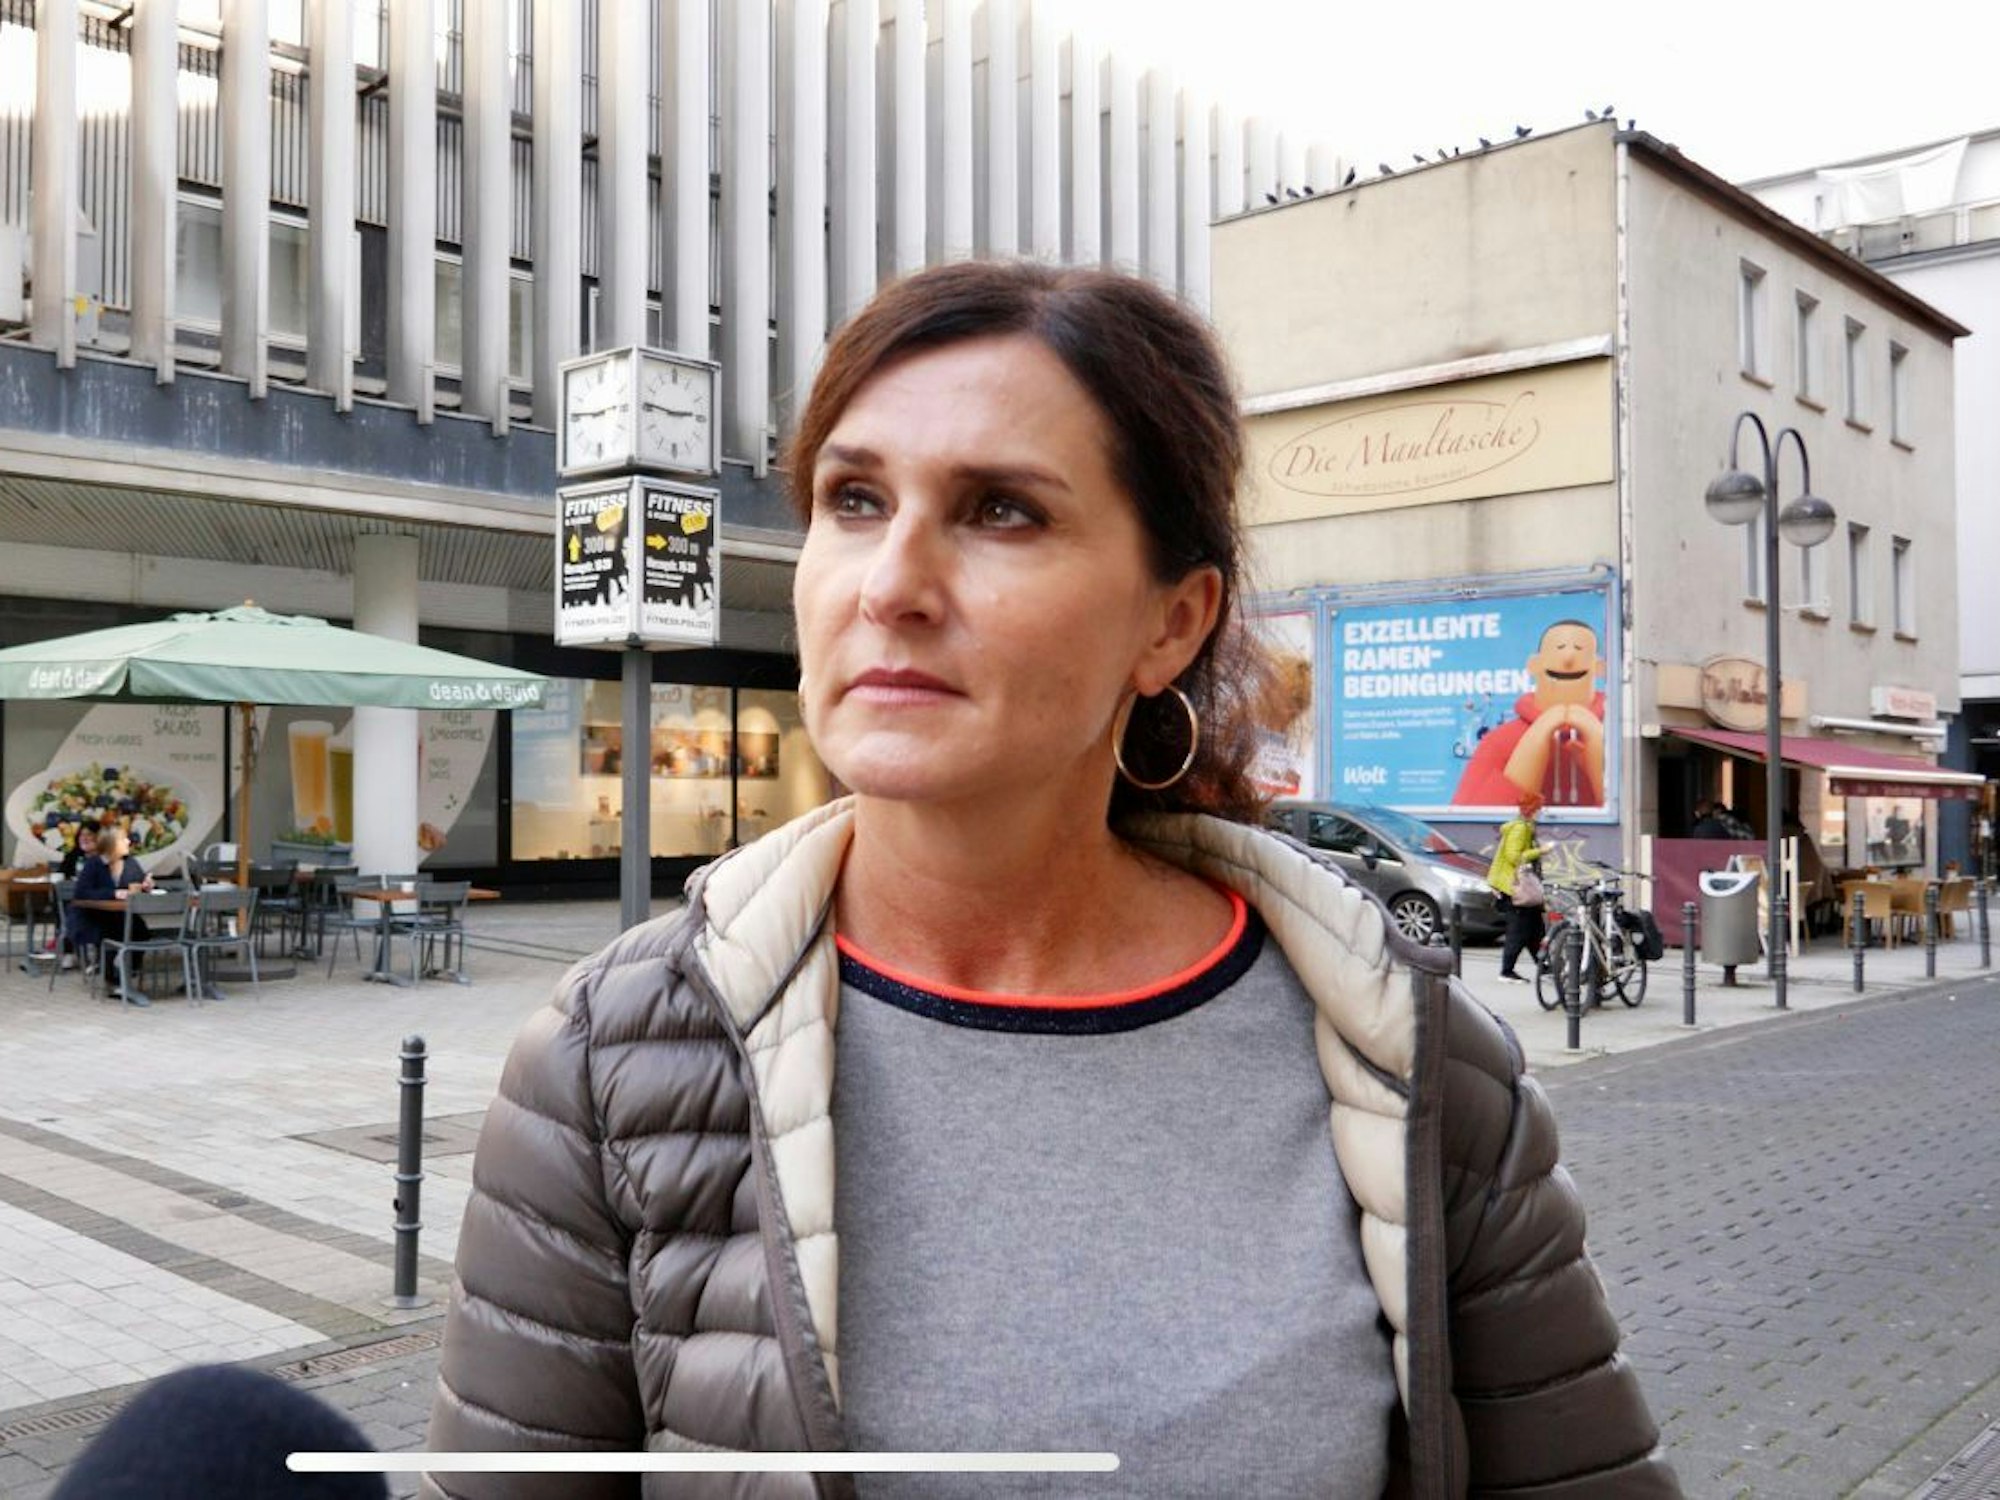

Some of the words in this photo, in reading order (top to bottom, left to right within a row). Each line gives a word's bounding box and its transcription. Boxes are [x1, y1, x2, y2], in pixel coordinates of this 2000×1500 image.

[1285, 445, 1337, 477] Die
[1345, 390, 1535, 473] Maultasche
[566, 493, 627, 516] FITNESS
[648, 494, 712, 517] FITNESS
[1344, 613, 1500, 644] EXZELLENTE
[1344, 646, 1443, 671] RAMEN-
[1344, 669, 1536, 698] BEDINGUNGEN.
[153, 719, 202, 737] SALADS
[1343, 765, 1388, 785] Wolt
